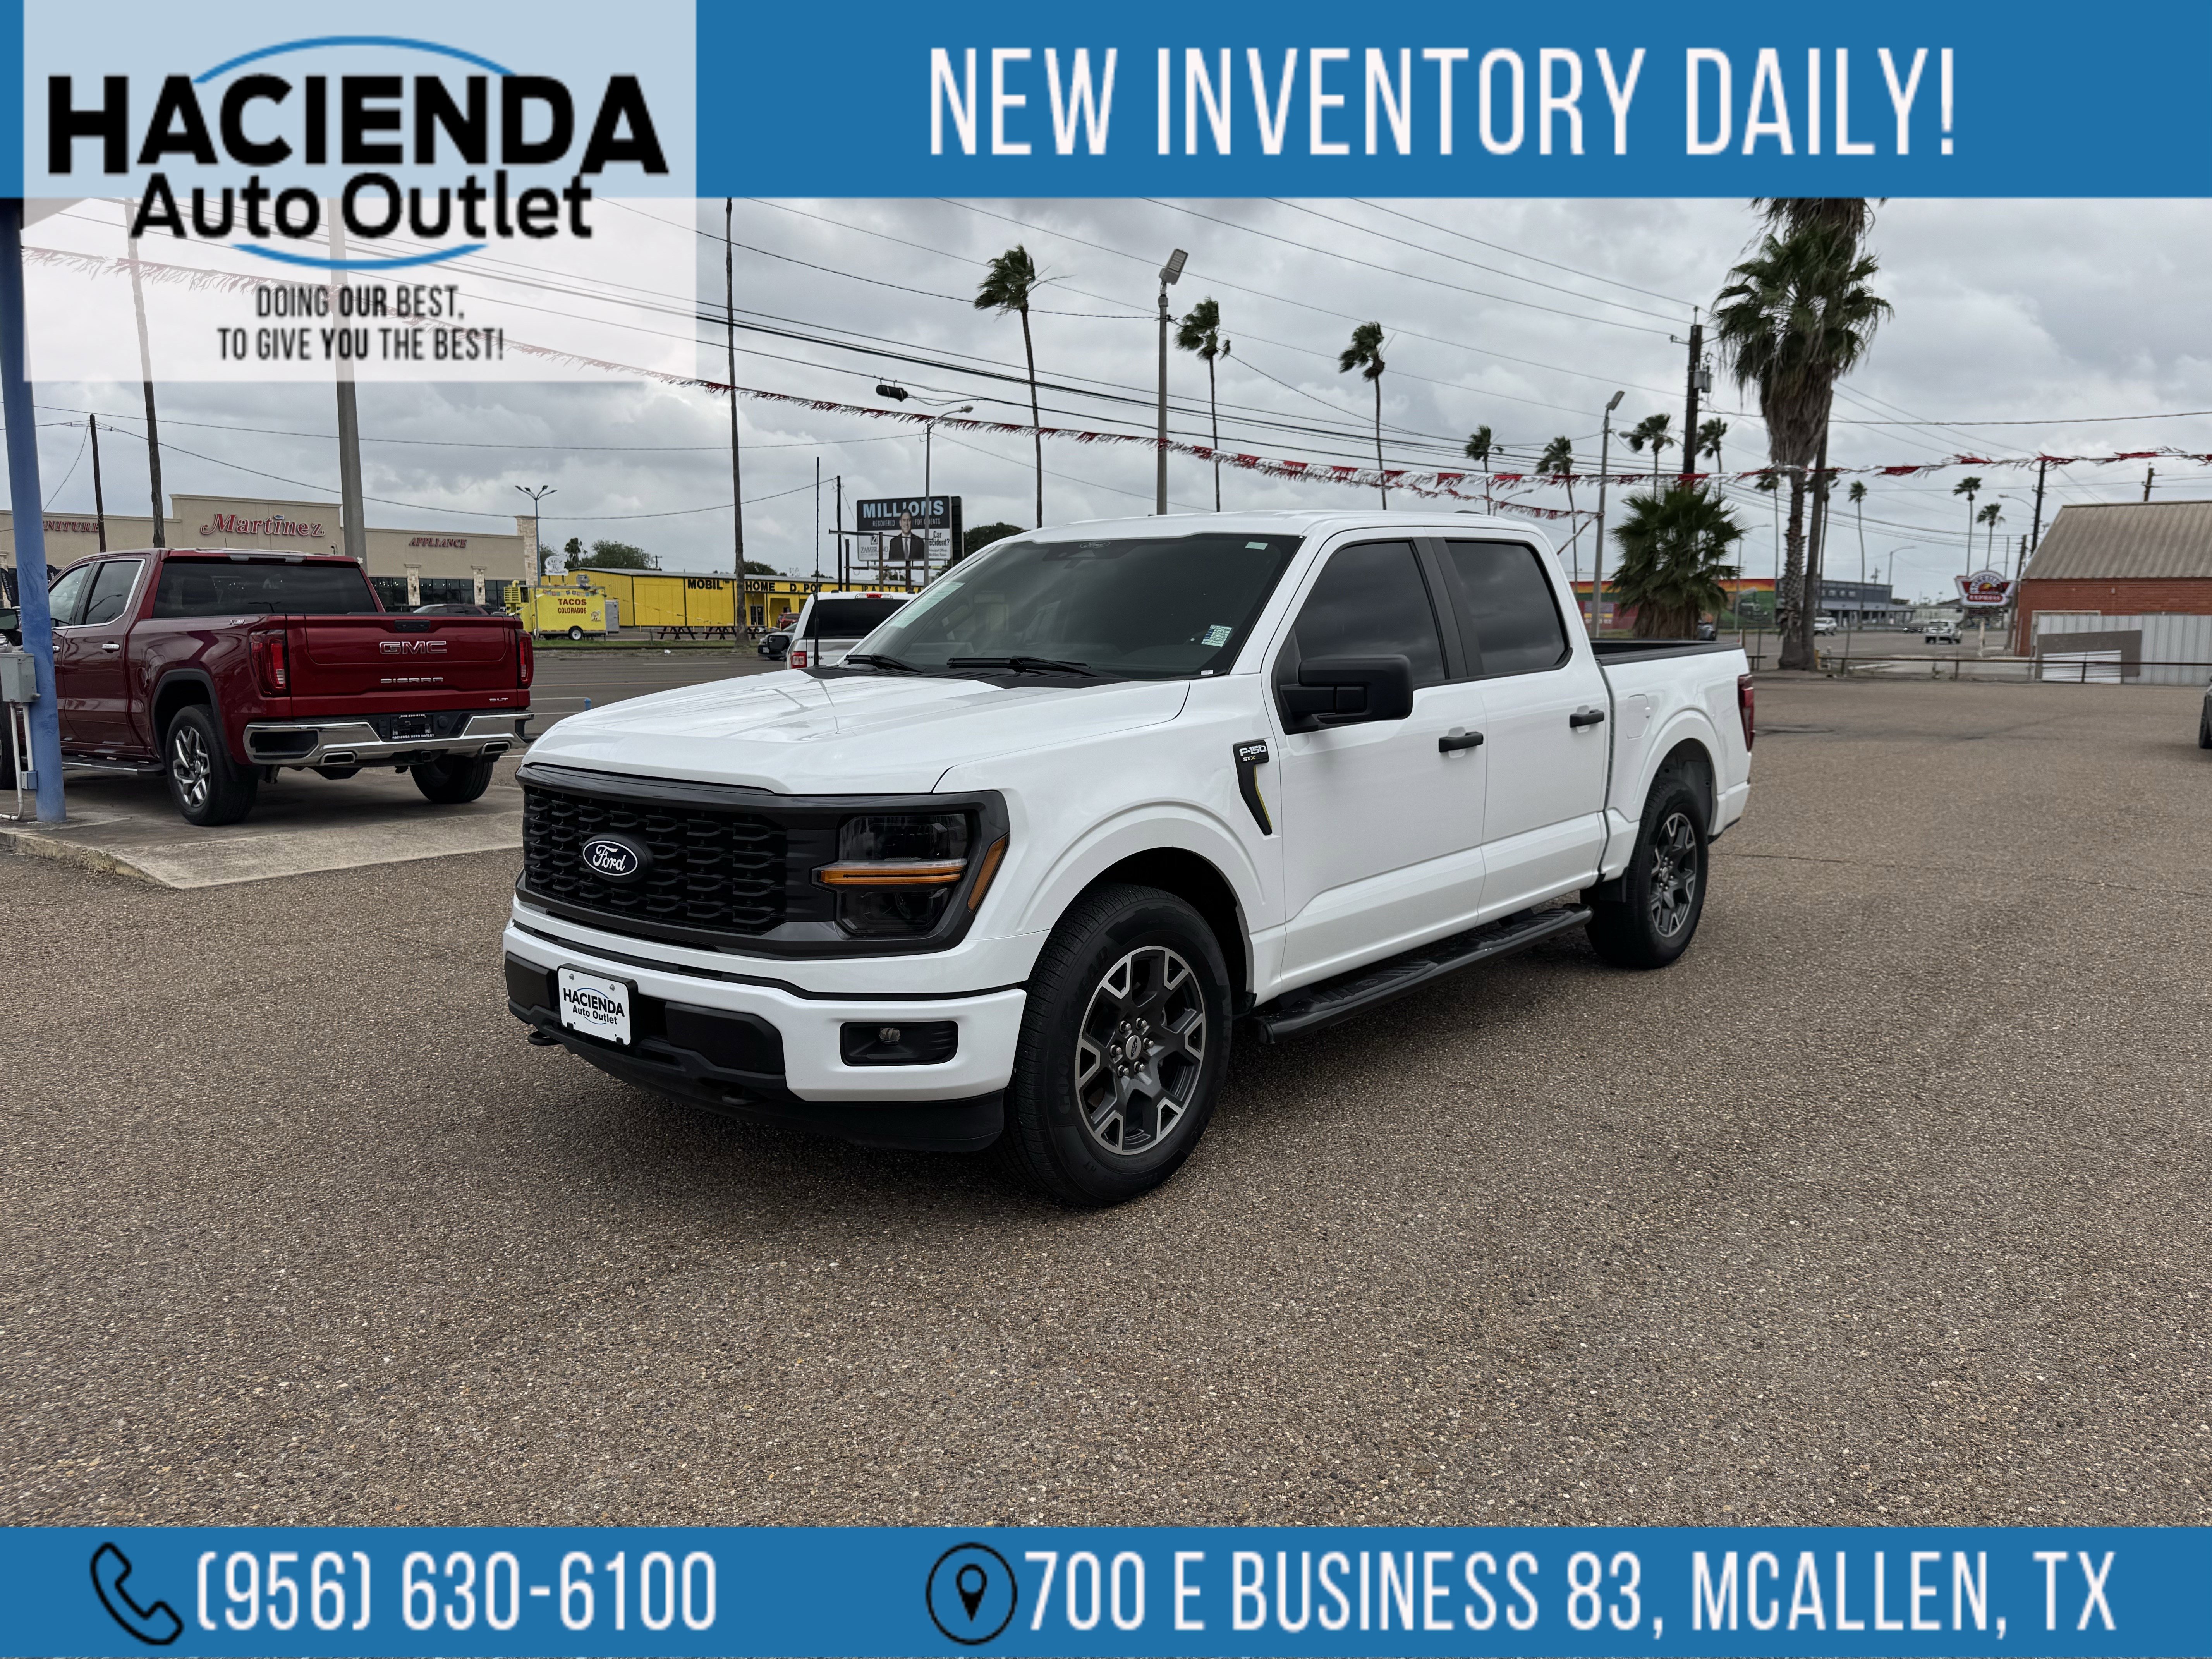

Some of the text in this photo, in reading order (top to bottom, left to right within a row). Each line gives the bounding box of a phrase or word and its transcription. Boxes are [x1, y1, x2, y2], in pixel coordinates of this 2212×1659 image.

[43, 520, 99, 532] NITURE
[201, 514, 326, 536] Martinez
[409, 537, 467, 548] APPLIANCE
[745, 581, 775, 591] HOME
[379, 641, 447, 654] GMC
[1239, 745, 1267, 756] F-150
[593, 843, 626, 872] Ford
[563, 988, 625, 1017] HACIENDA
[572, 1005, 618, 1025] Auto Outlet
